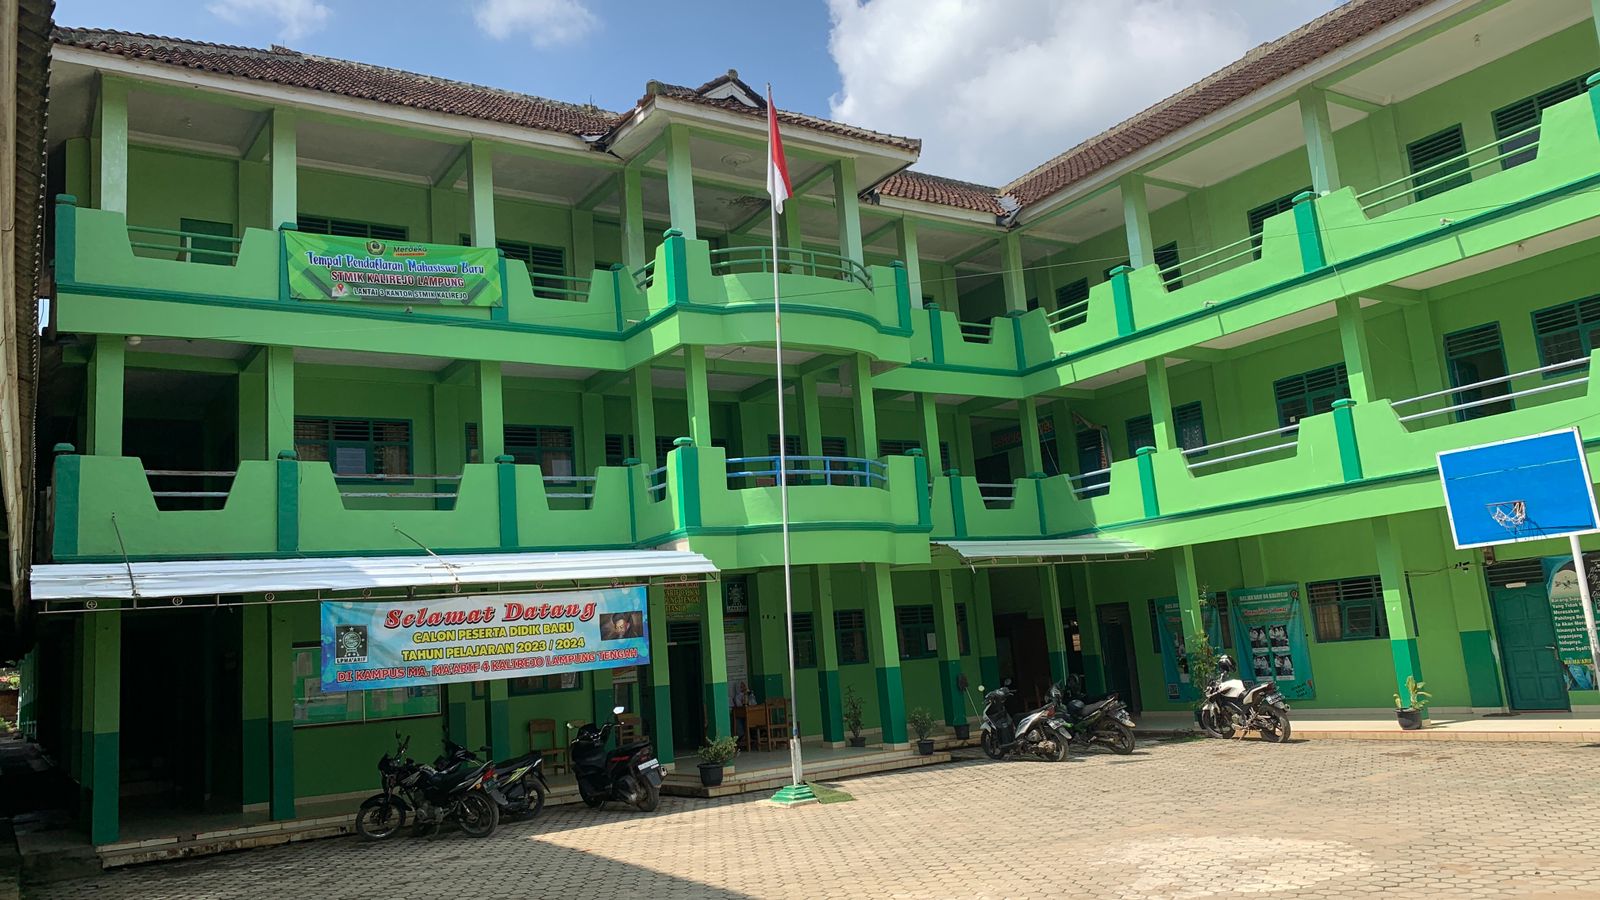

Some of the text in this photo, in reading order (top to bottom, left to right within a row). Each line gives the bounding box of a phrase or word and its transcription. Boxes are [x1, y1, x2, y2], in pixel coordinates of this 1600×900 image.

[406, 259, 457, 274] Mahasiswa
[460, 261, 485, 274] Baru
[331, 270, 464, 287] STMIK KALIREJO LAMPUNG
[353, 287, 378, 296] LANTAI
[385, 289, 414, 298] KANTOR
[414, 290, 436, 299] STMIK
[436, 291, 468, 300] KALIREJO
[384, 602, 597, 629] Selamat Datang
[412, 622, 574, 644] CALON PESERTA DIDIK BARU
[401, 637, 585, 661] TAHUN PELAJARAN 2023 / 2024
[337, 648, 638, 683] DI KAMPUS MA. MA'ARIF 4 KALIREJO LAMPUNG TENGAH
